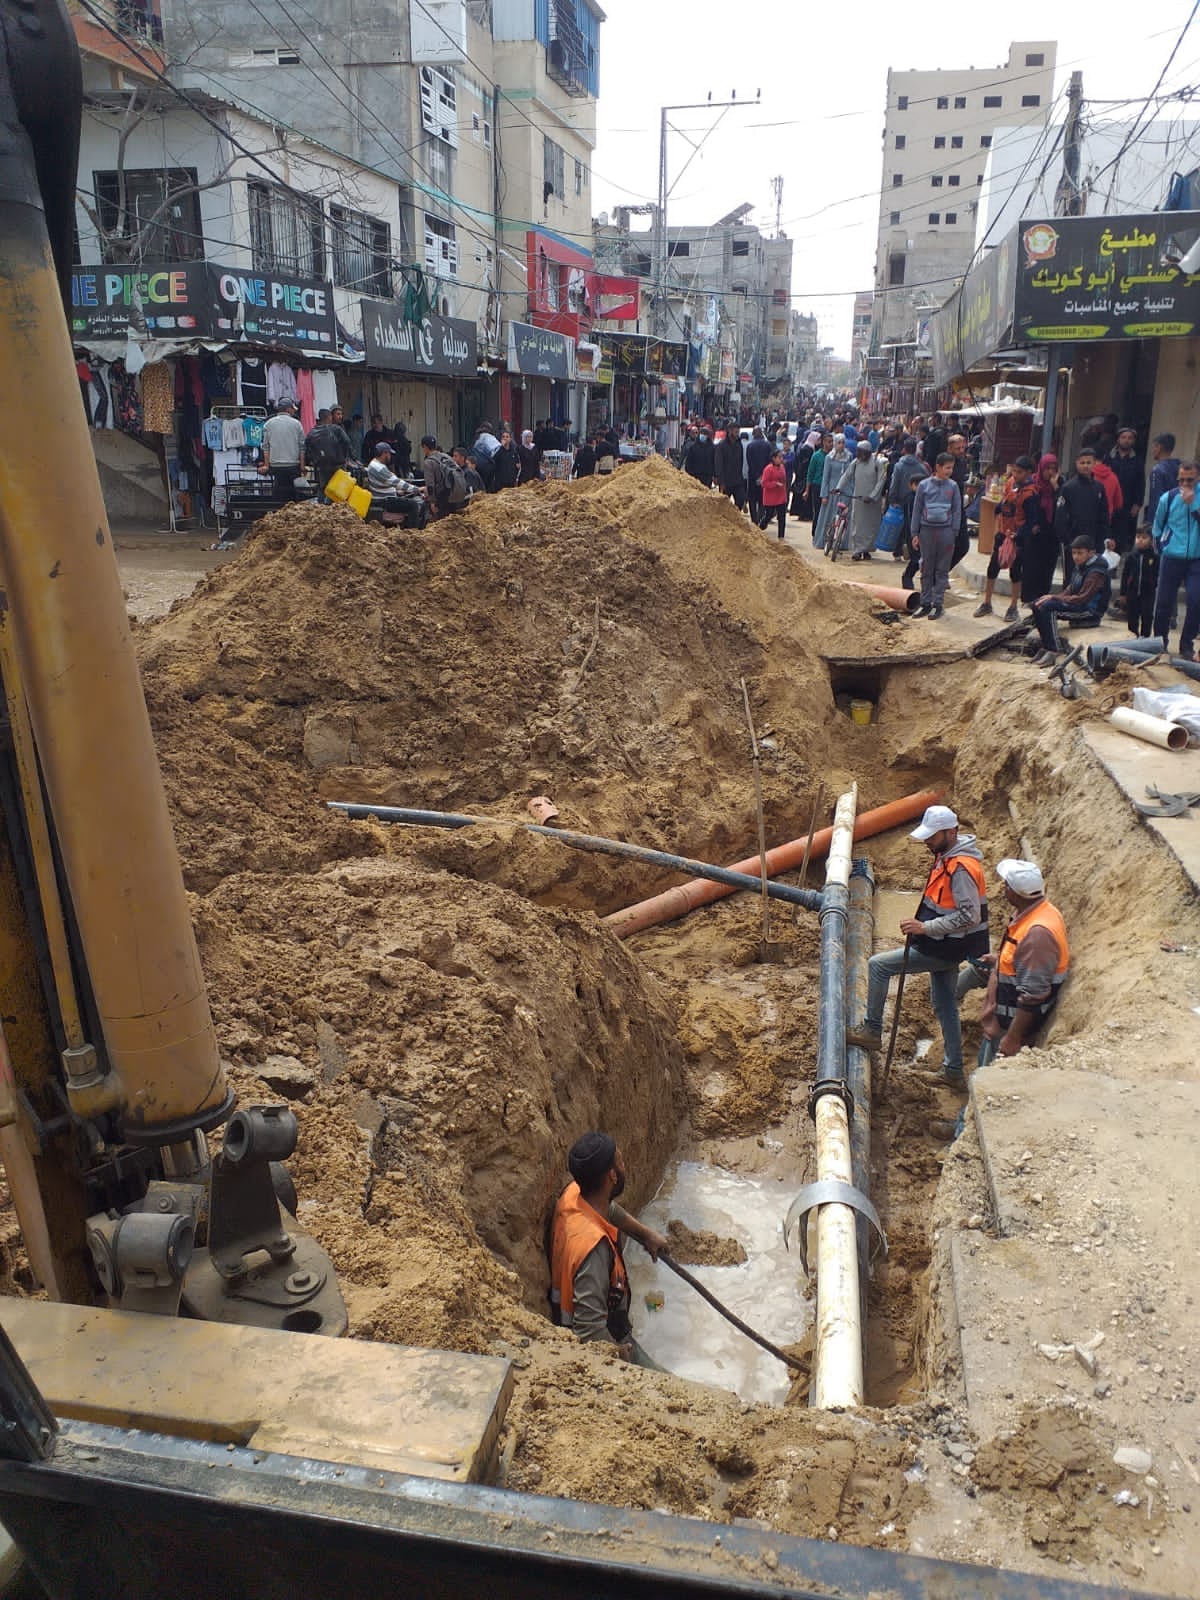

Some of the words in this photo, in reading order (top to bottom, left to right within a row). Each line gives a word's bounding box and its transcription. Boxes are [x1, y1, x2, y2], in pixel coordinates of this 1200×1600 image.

[1100, 226, 1156, 256] مطبخ
[105, 271, 188, 306] PIECE
[1031, 265, 1083, 293] كويك
[1085, 262, 1115, 292] أبو
[1119, 263, 1178, 293] حسني
[220, 274, 267, 307] ONE
[271, 282, 326, 316] PIECE
[1064, 299, 1111, 316] المناسبات
[1113, 300, 1140, 316] جميع
[1143, 297, 1175, 313] لتلبية
[374, 313, 414, 352] الشهداء
